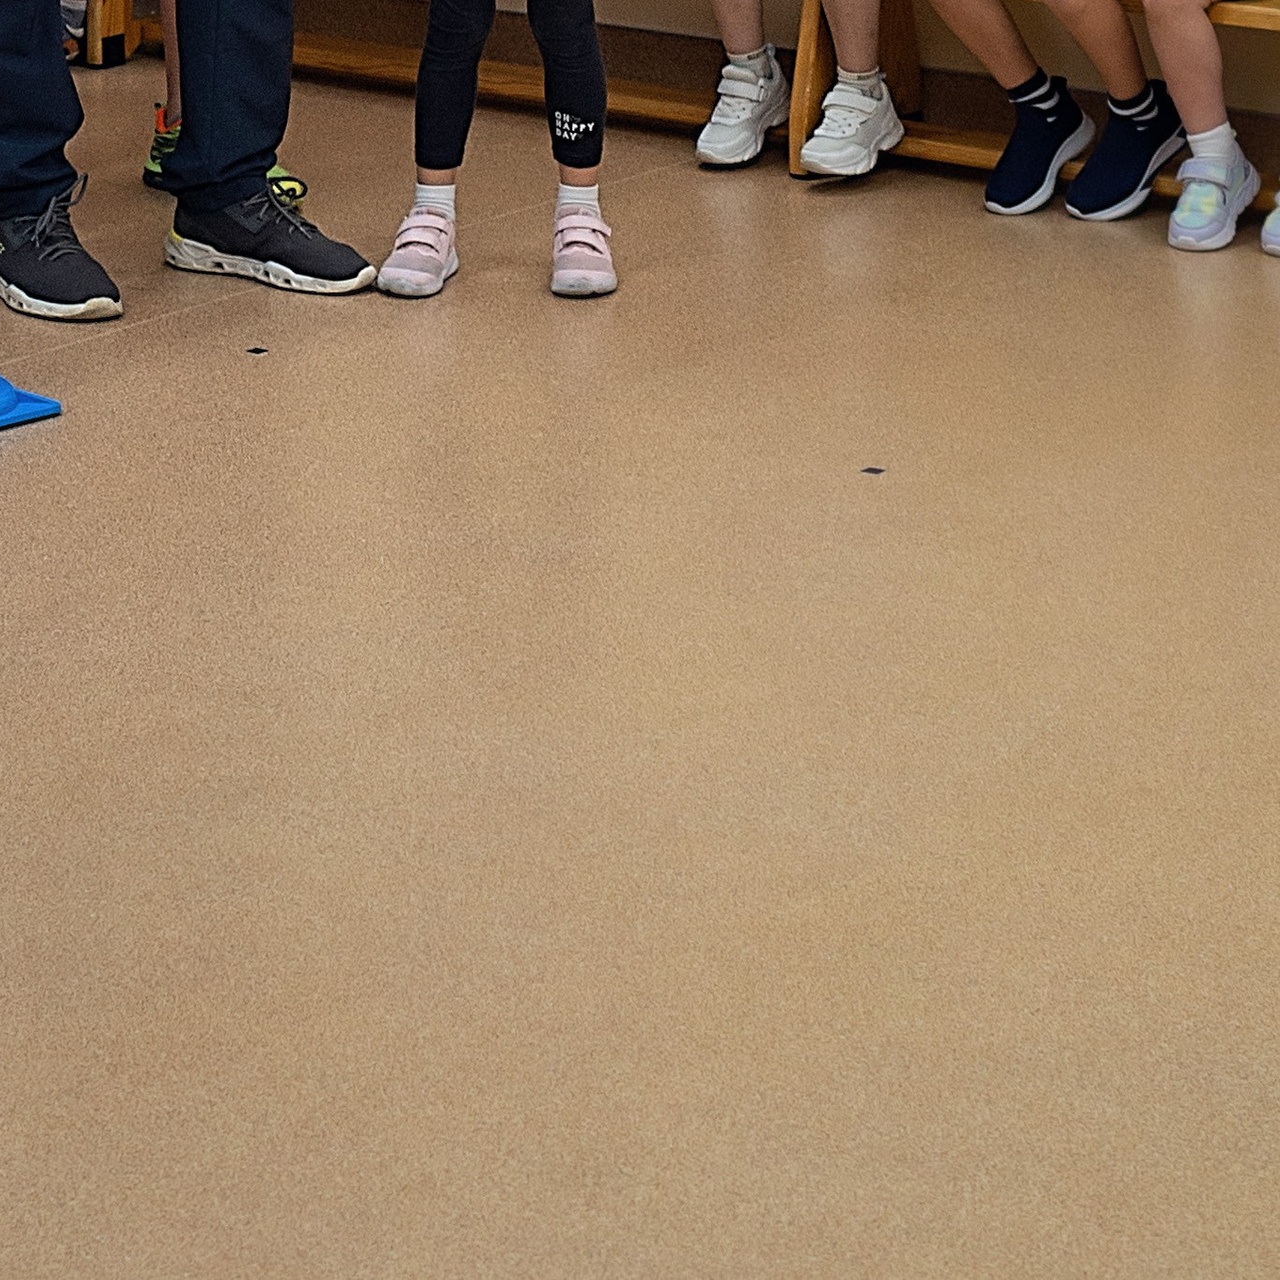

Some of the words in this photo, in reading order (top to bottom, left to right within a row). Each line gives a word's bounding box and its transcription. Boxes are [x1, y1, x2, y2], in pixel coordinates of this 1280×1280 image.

[555, 111, 570, 122] OH
[555, 120, 595, 132] HAPPY
[555, 127, 577, 141] DAY
